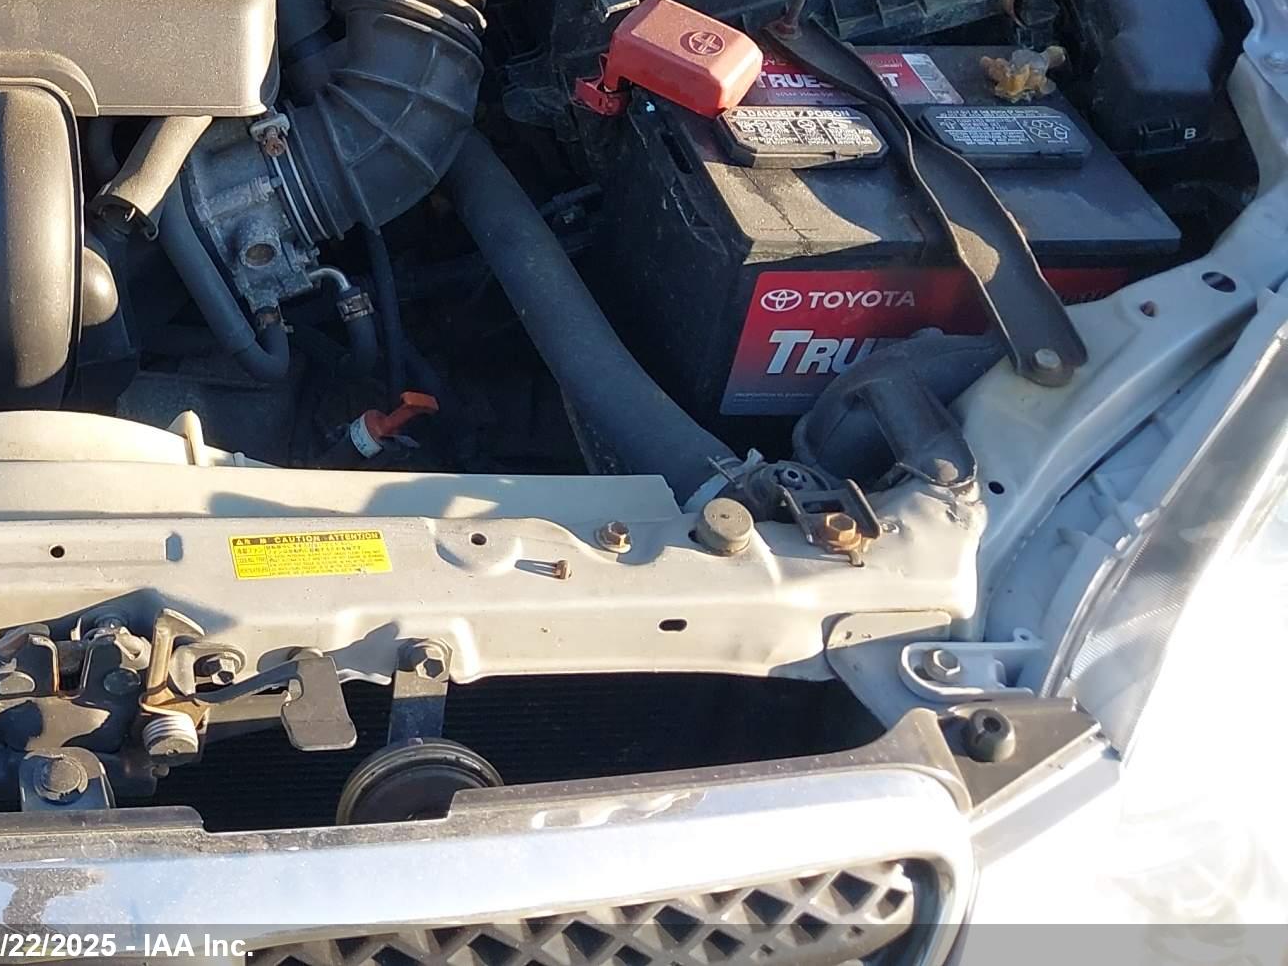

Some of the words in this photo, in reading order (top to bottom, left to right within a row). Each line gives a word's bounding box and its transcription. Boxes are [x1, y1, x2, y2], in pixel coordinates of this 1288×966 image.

[1184, 128, 1197, 140] B
[808, 290, 916, 309] TOYOTA
[274, 535, 320, 544] CAUTION
